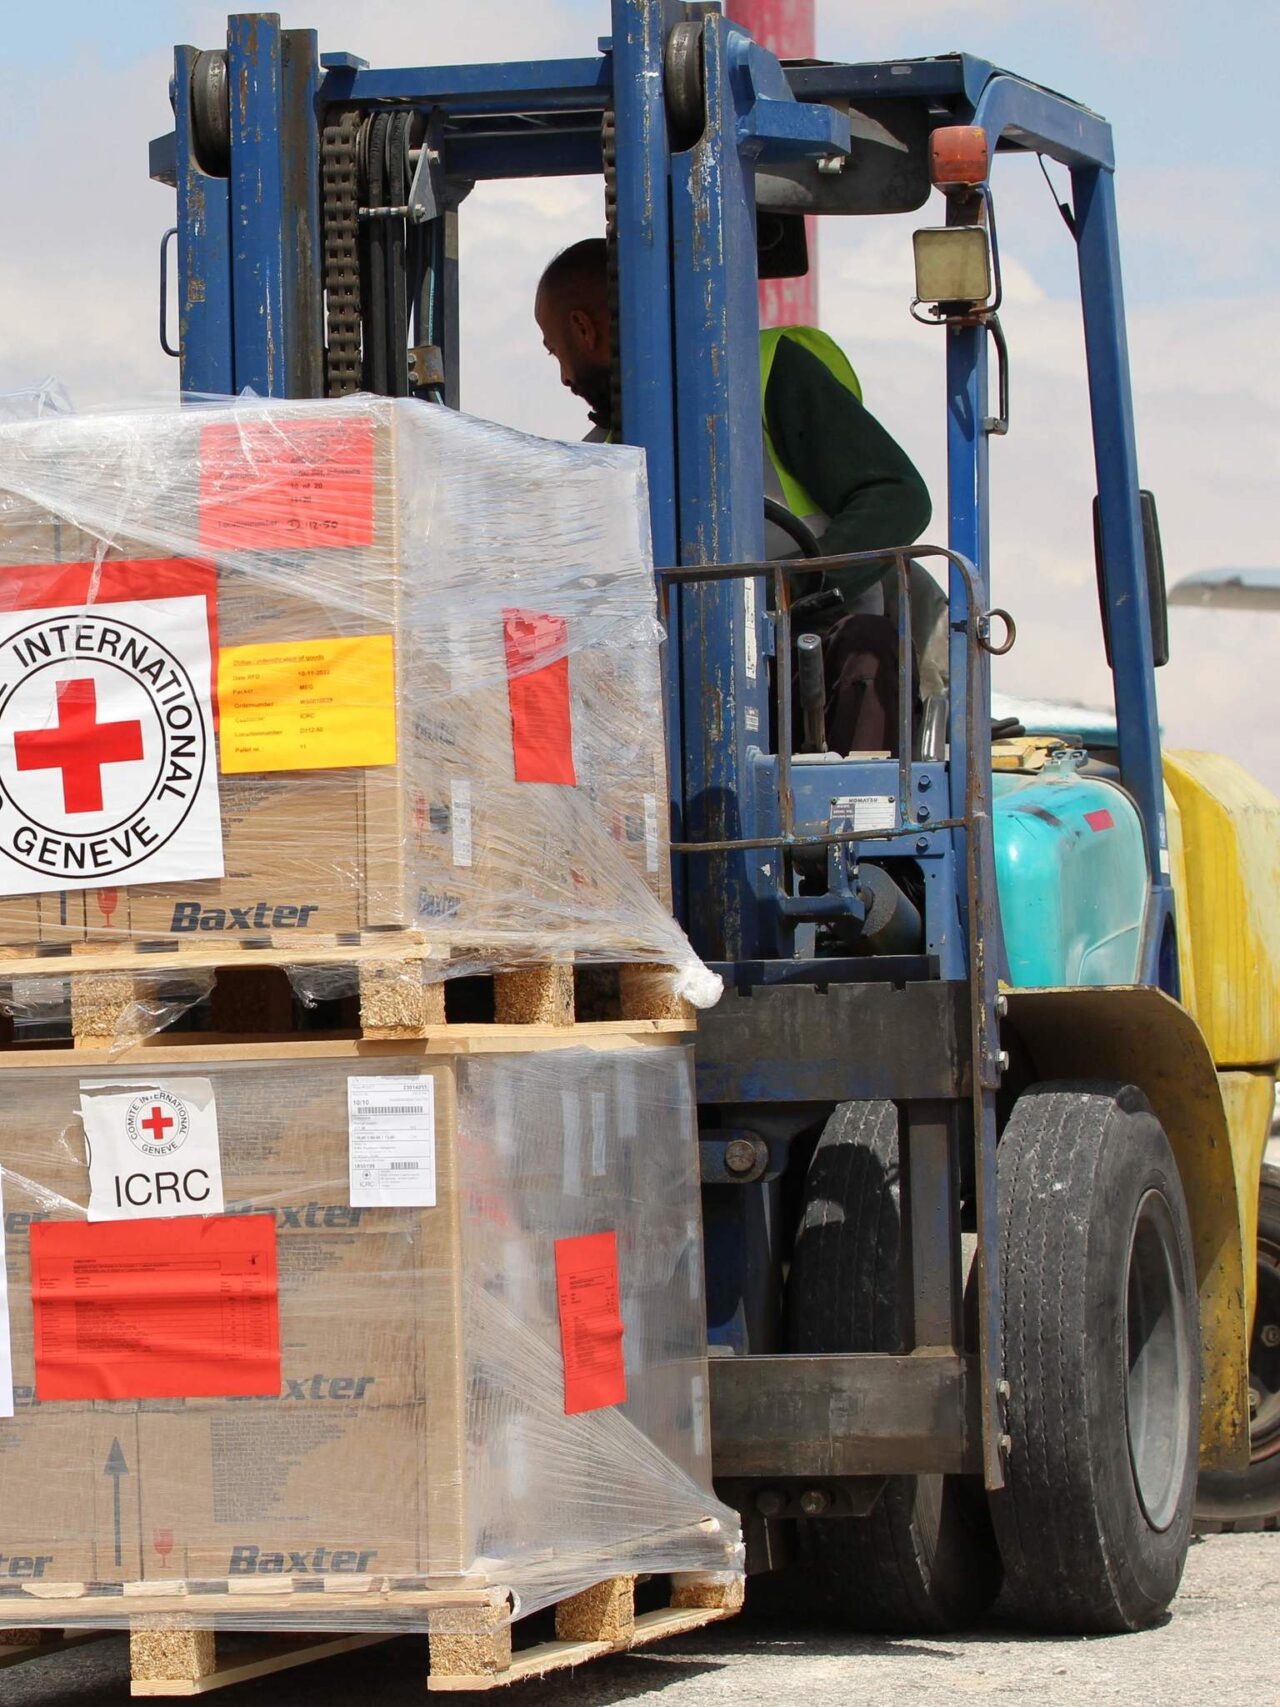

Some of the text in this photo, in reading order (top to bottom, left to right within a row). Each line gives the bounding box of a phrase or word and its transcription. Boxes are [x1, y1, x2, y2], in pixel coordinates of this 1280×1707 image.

[12, 623, 196, 801] INTERNATIONAL
[12, 816, 160, 869] GENEVE
[169, 901, 320, 933] Baxter
[127, 1103, 140, 1141] COMITE
[141, 1141, 179, 1155] GENEVE
[114, 1168, 211, 1208] ICRC
[228, 1545, 378, 1575] Baxter
